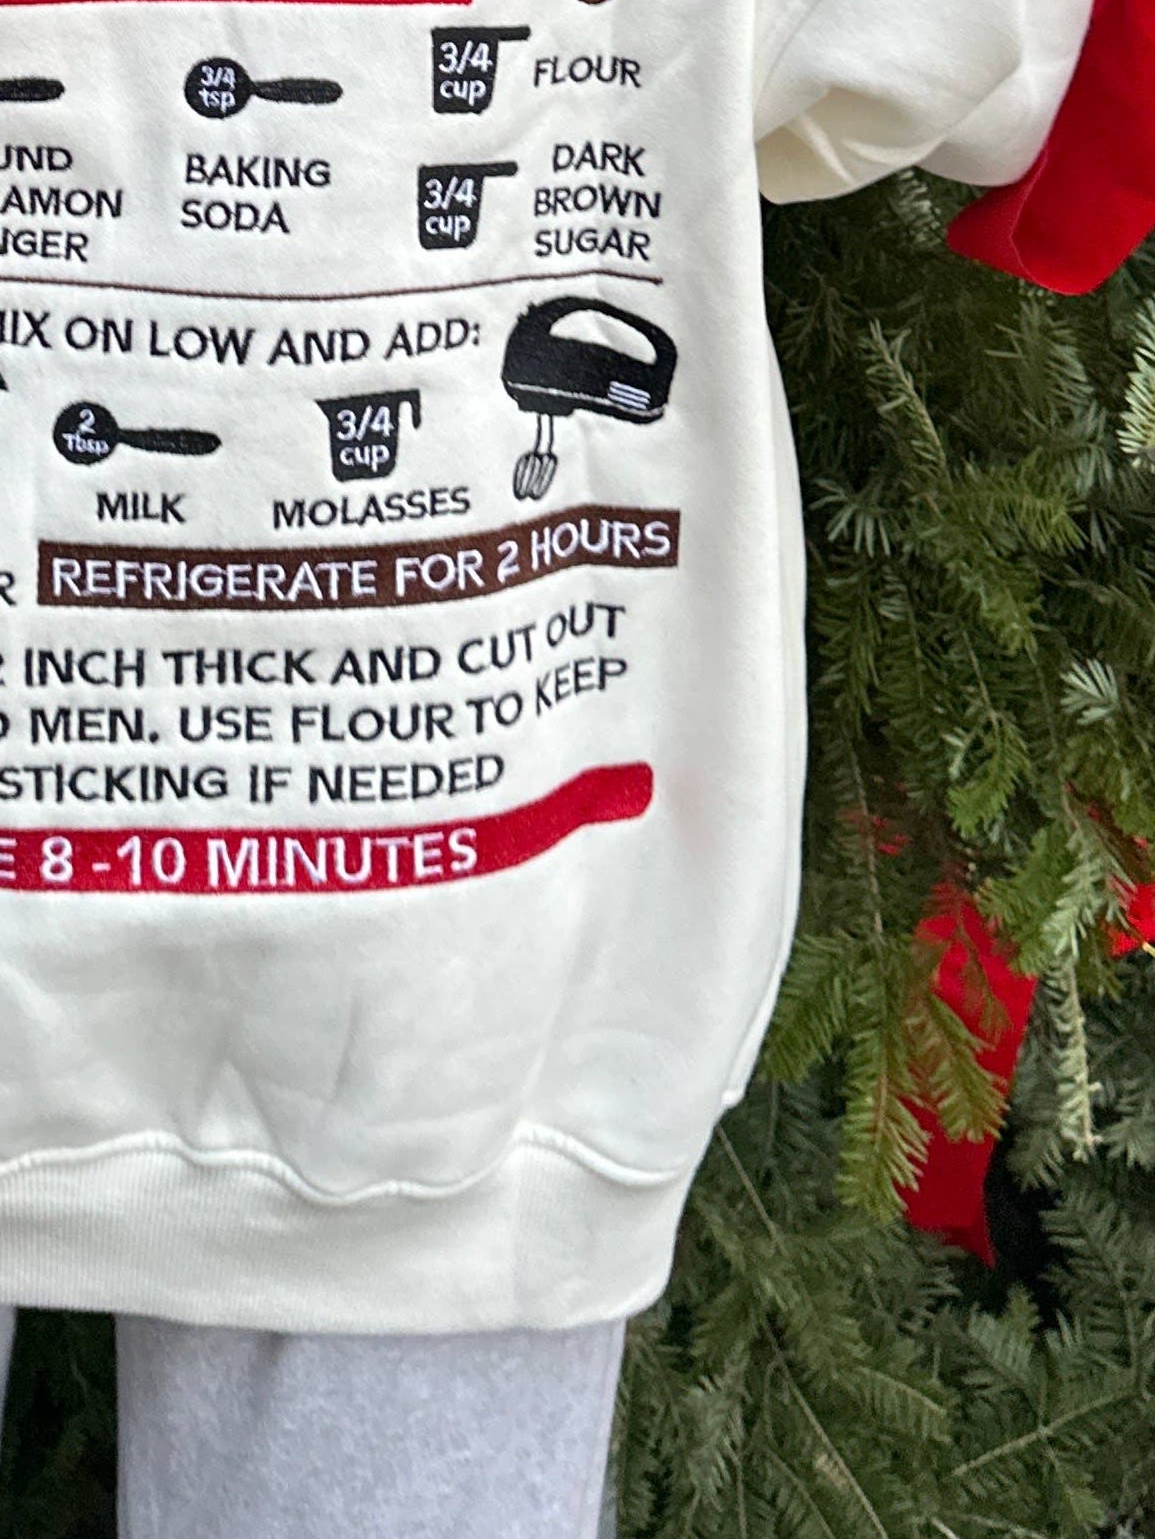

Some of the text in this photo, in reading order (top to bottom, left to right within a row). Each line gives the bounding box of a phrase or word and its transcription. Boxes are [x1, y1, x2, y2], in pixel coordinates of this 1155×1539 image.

[439, 41, 493, 73] 3/4
[534, 55, 641, 88] FLOUR
[199, 65, 237, 89] 3/4
[199, 89, 235, 111] tsp
[440, 79, 485, 110] cup
[185, 153, 332, 190] BAKING
[552, 142, 646, 178] DARK
[424, 176, 477, 208] 3/4
[534, 184, 661, 219] BROWN
[180, 200, 290, 234] SODA
[425, 214, 471, 241] cup
[534, 229, 652, 262] SUGAR
[65, 317, 133, 353] ON
[150, 321, 256, 364] LOW
[267, 327, 369, 365] AND
[383, 318, 481, 359] ADD:
[79, 409, 96, 434] 2
[336, 406, 393, 439] 3/4
[61, 432, 110, 456] Tbsp
[341, 443, 391, 469] cup
[96, 492, 187, 524] MILK
[273, 486, 471, 528] MOLASSES
[53, 517, 671, 601] REFRIGERATE FOR 2 HOURS
[24, 647, 145, 688] INCH
[162, 649, 316, 686] THICK
[330, 645, 441, 686] AND
[457, 624, 538, 674] CUT
[545, 602, 627, 648] OUT
[30, 707, 161, 744] MEN.
[179, 706, 273, 743] USE
[291, 702, 455, 742] FLOUR
[466, 692, 523, 735] TO
[535, 657, 628, 717] KEEP
[249, 765, 292, 804] IF
[308, 753, 505, 803] NEEDED
[39, 836, 73, 883] 8
[207, 827, 479, 888] MINUTES
